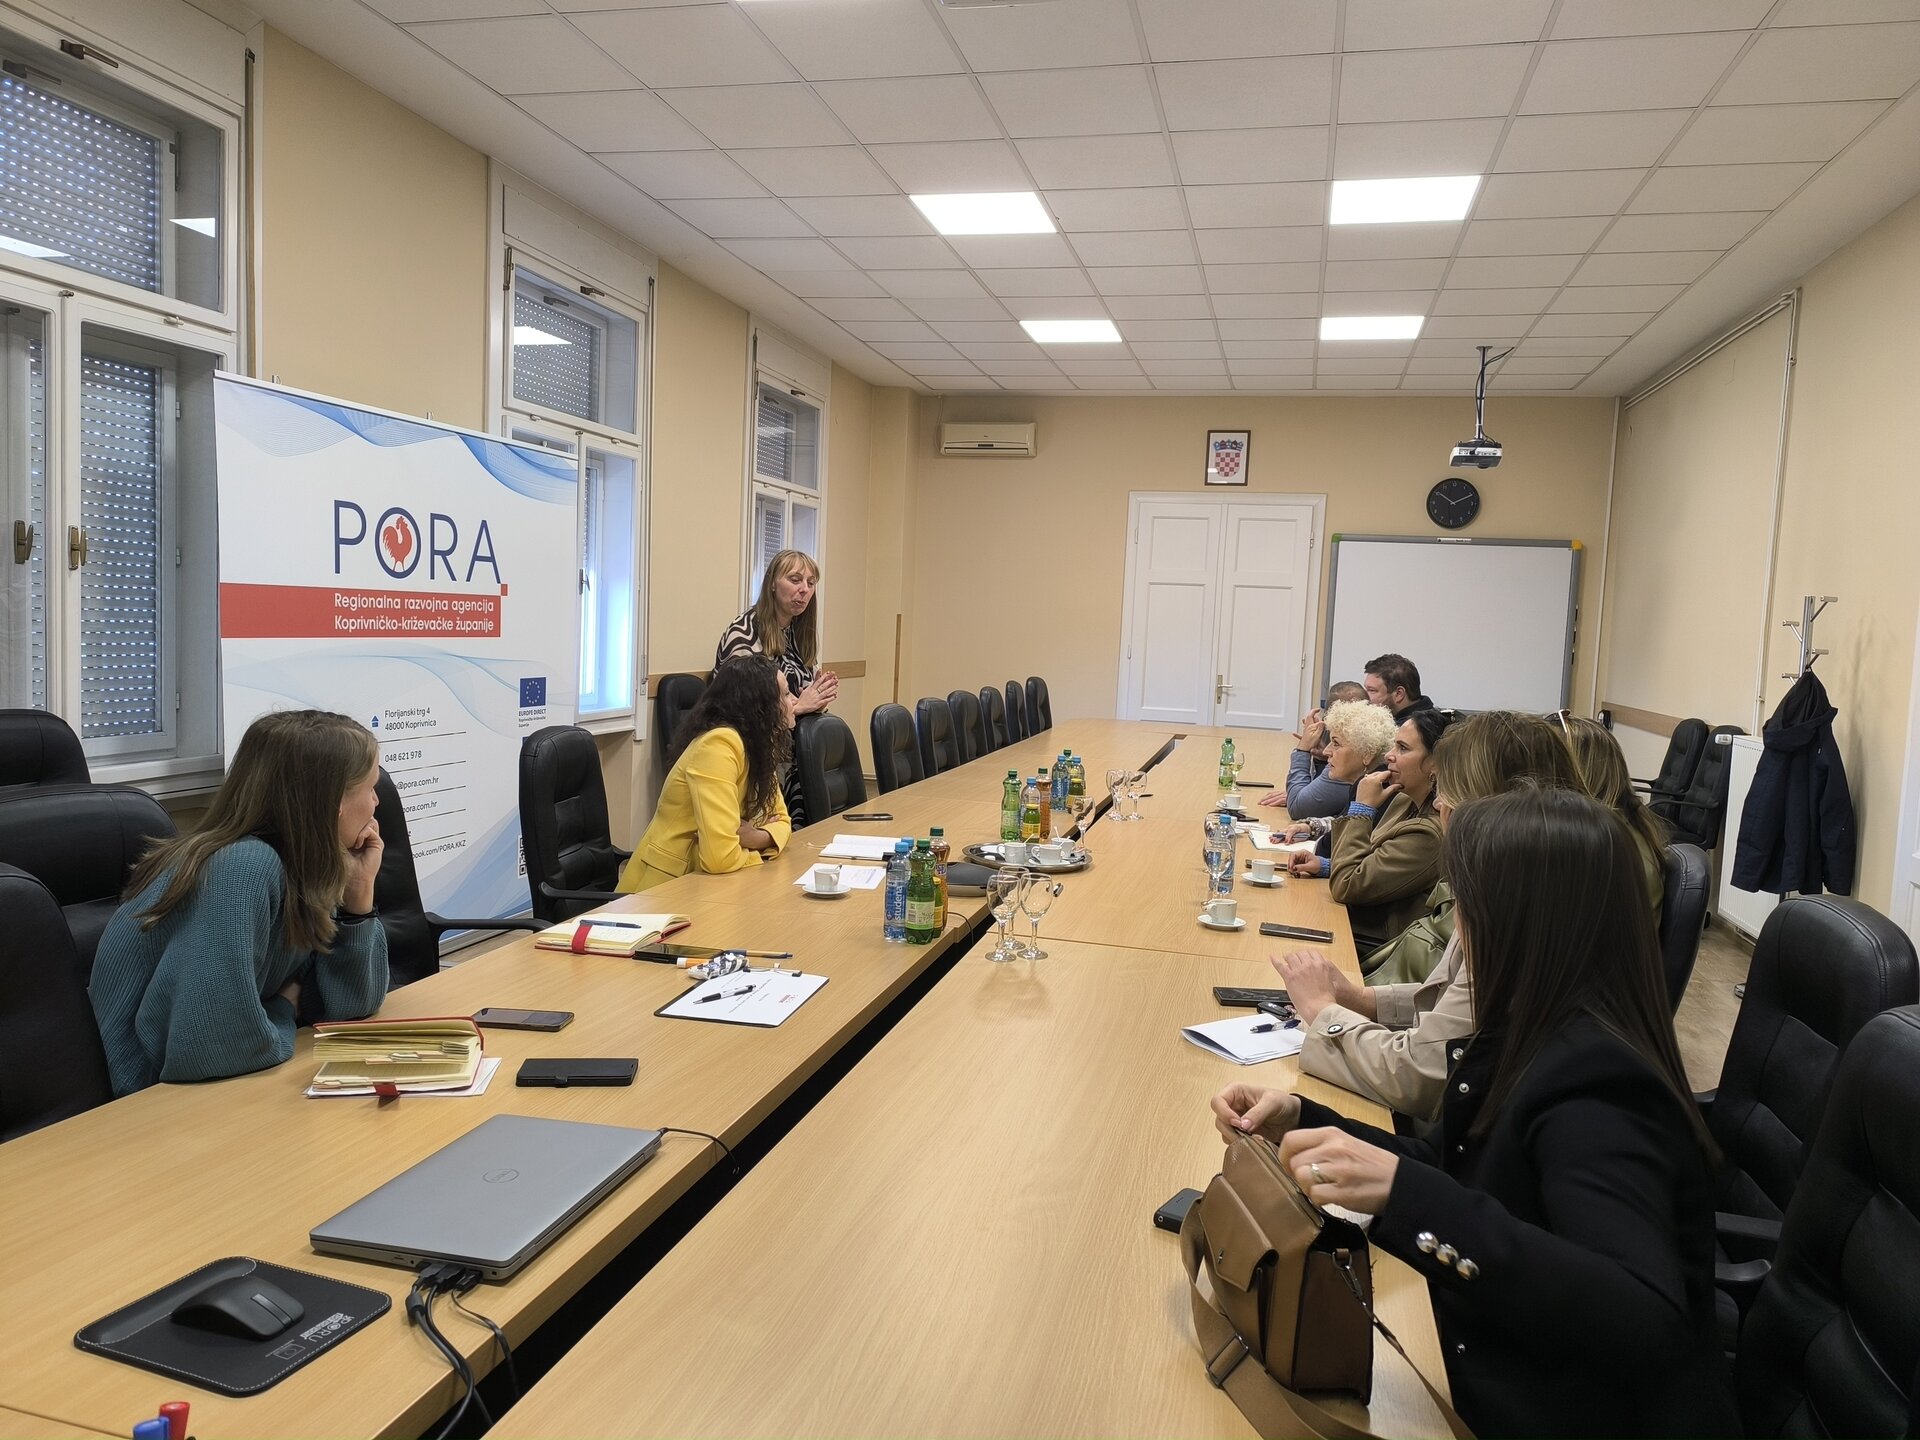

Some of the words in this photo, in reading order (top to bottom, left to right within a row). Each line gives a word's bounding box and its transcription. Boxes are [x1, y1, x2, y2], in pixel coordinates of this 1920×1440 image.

[334, 499, 502, 584] PORA
[334, 592, 401, 612] Regionalna
[404, 597, 449, 613] razvojna
[451, 599, 494, 614] agencija
[334, 615, 454, 633] Koprivničko-križevačke
[455, 618, 494, 634] županije
[384, 708, 416, 720] Florijanski
[416, 708, 426, 718] trg
[518, 709, 534, 717] EUROPE
[533, 708, 547, 716] DIRECT
[384, 720, 405, 731] 48000
[405, 718, 437, 730] Koprivnica
[384, 752, 398, 763] 048
[397, 751, 410, 761] 621
[410, 750, 422, 760] 978
[394, 776, 439, 791] @pora.com.hr
[894, 886, 903, 920] studena
